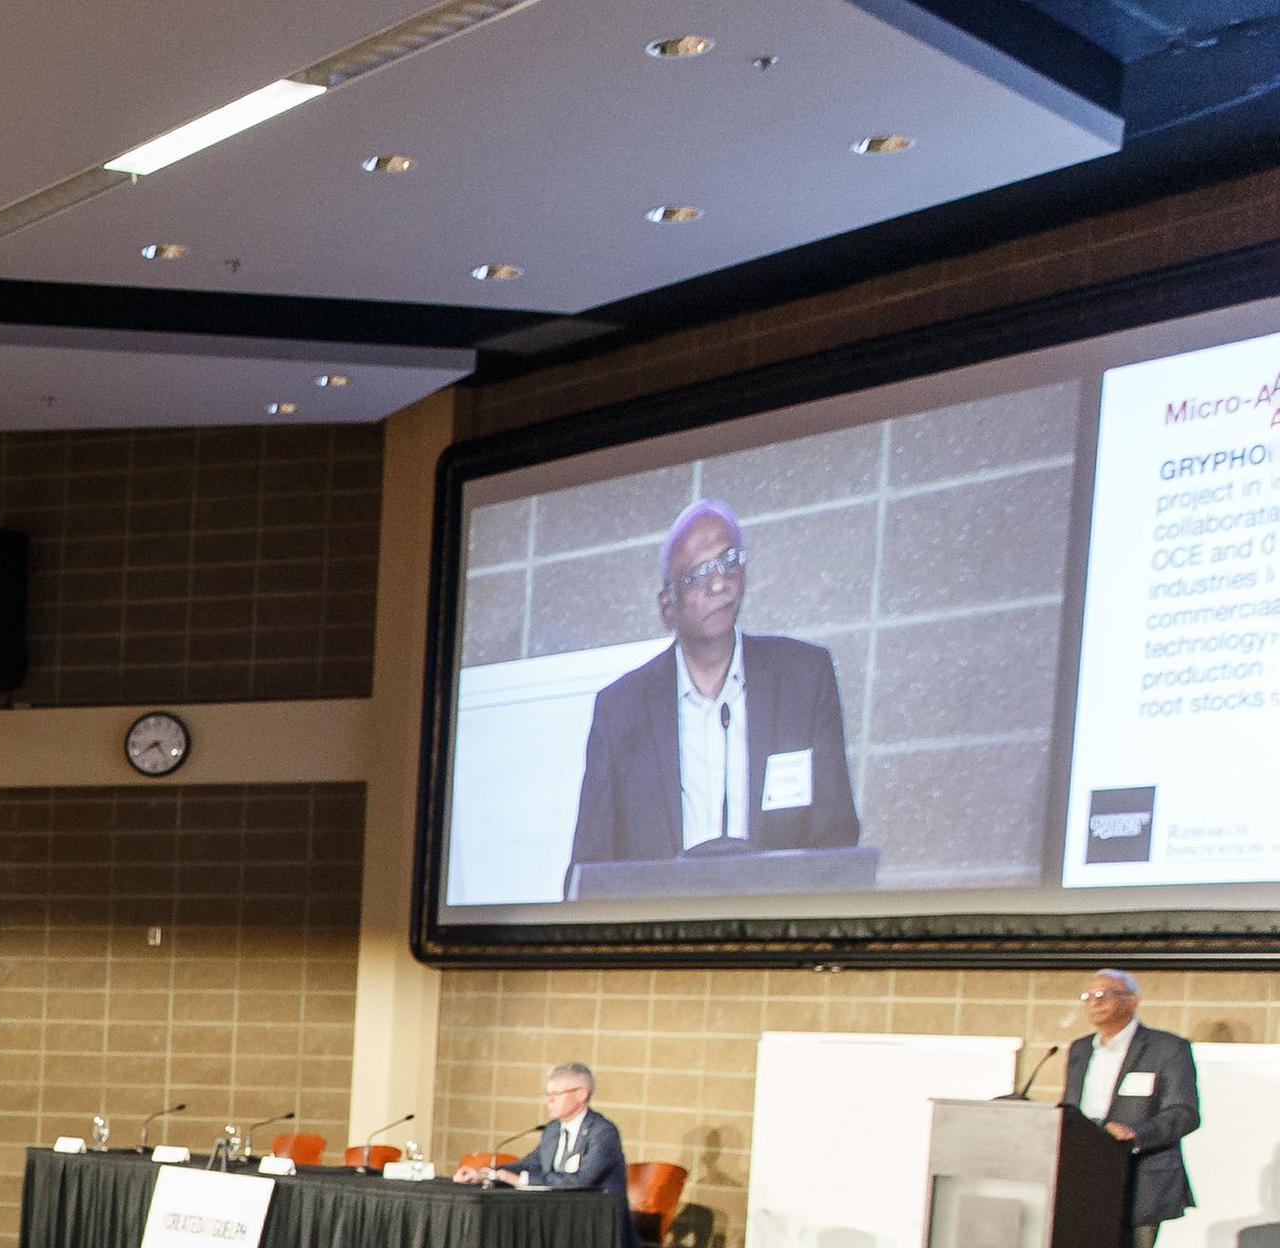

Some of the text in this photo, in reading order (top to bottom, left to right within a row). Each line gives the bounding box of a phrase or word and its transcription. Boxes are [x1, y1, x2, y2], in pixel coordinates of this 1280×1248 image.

[1160, 444, 1272, 480] GRYPHO
[1157, 482, 1233, 514] project
[1151, 544, 1202, 571] OCE
[1210, 539, 1253, 563] and
[1149, 570, 1257, 599] industries
[1141, 661, 1263, 693] production
[1139, 697, 1183, 717] root
[1190, 690, 1264, 713] stocks
